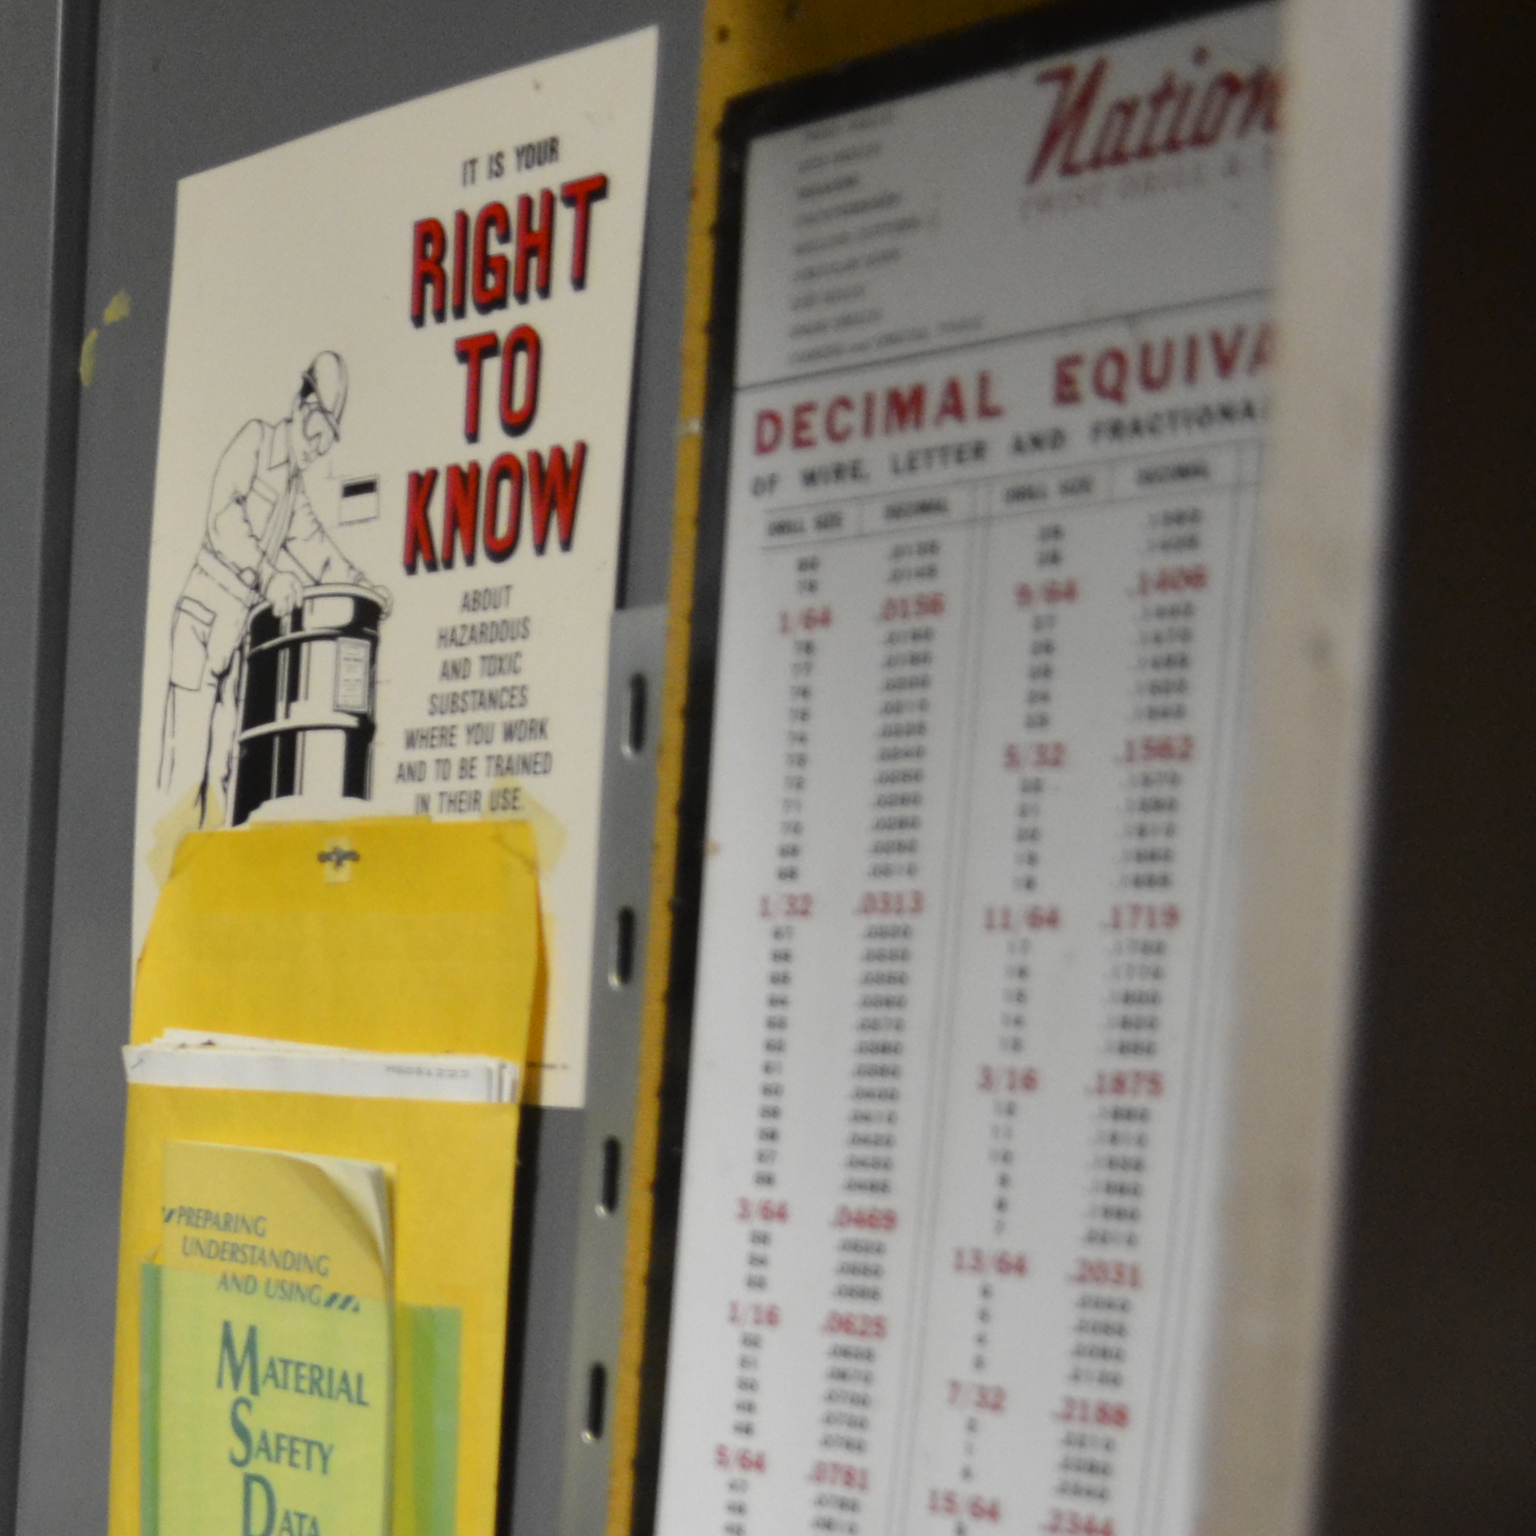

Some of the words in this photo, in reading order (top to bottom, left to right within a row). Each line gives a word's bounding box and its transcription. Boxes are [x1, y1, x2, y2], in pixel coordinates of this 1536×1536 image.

[461, 158, 478, 187] IT
[486, 152, 505, 180] IS
[514, 136, 560, 172] YOUR
[410, 173, 609, 329] RIGHT
[455, 323, 542, 444] TO
[754, 370, 1006, 457] DECIMAL
[750, 473, 780, 498] OF
[891, 438, 988, 477] LETTER
[1012, 427, 1068, 458] AND
[403, 440, 587, 576] KNOW
[460, 584, 514, 614] ABOUT
[436, 616, 531, 649] HAZARDOUS
[439, 656, 472, 682] AND
[480, 650, 524, 679] TOXIC
[427, 683, 530, 717] SUBSTANCES
[404, 723, 459, 751] WHERE
[464, 720, 496, 746] YOU
[502, 716, 551, 744] WORK
[394, 759, 428, 784] AND
[434, 757, 452, 781] TO
[458, 755, 478, 780] BE
[484, 750, 554, 778] TRAINED
[414, 792, 431, 814] IN
[437, 788, 482, 814] THEIR
[488, 786, 523, 812] USE
[176, 1204, 268, 1239] PREPARING
[181, 1234, 331, 1278] UNDERSTANDING
[216, 1272, 260, 1301] AND
[263, 1279, 323, 1308] USING
